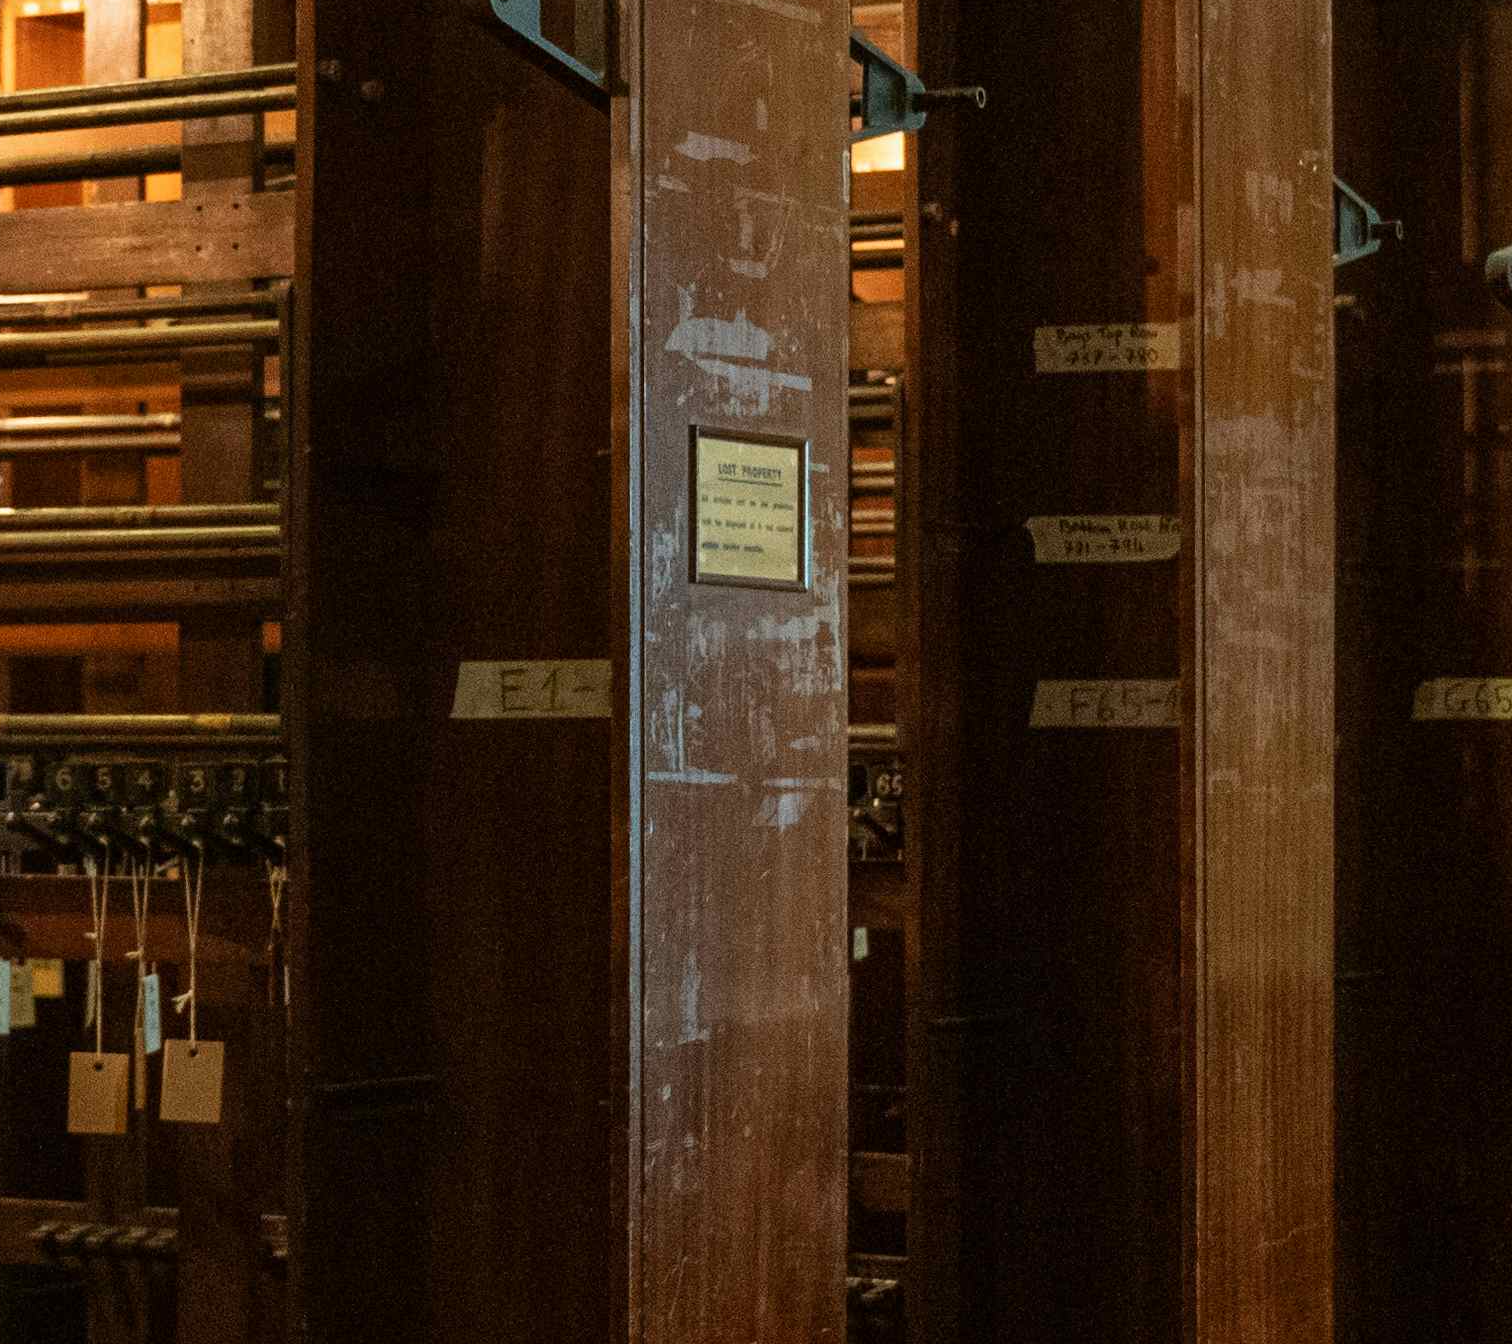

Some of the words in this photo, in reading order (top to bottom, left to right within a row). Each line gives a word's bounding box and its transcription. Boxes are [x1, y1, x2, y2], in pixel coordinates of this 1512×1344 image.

[56, 767, 73, 791] 6
[97, 766, 112, 791] 5
[137, 769, 153, 790] 4
[189, 768, 206, 794] 3
